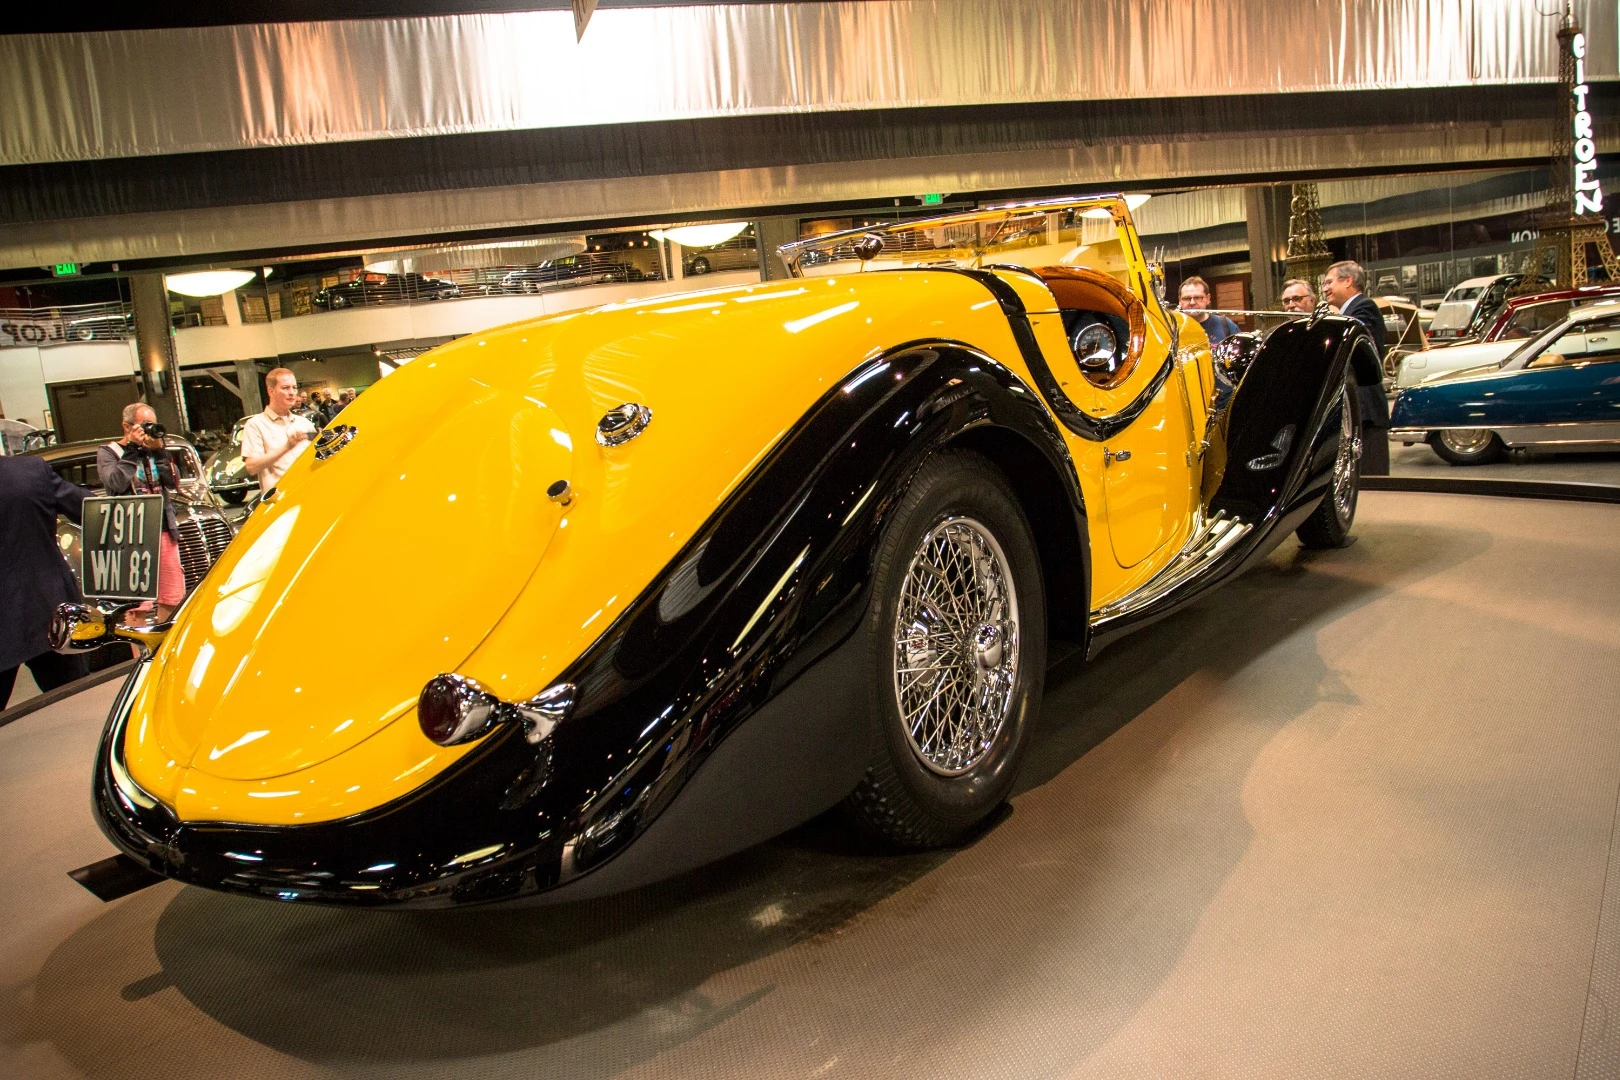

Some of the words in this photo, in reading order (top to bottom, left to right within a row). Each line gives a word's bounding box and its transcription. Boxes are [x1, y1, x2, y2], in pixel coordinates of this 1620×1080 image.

[55, 263, 77, 275] EXIT
[99, 502, 145, 545] 7911
[90, 550, 121, 592] WN
[129, 550, 151, 593] 83
